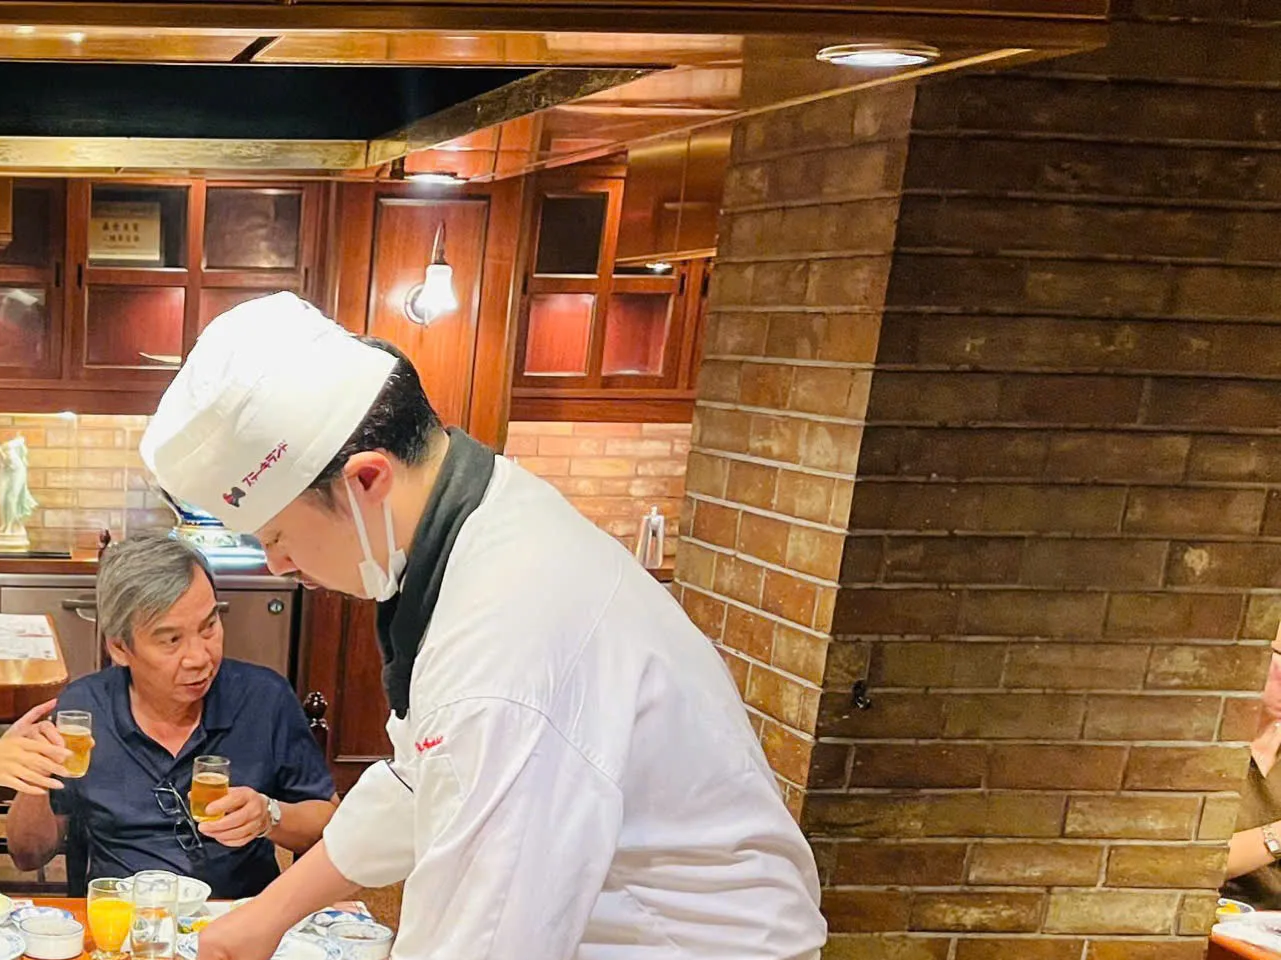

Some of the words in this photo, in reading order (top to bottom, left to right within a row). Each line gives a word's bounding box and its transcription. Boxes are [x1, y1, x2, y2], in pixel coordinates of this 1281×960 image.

[241, 439, 289, 487] ステーキランド
